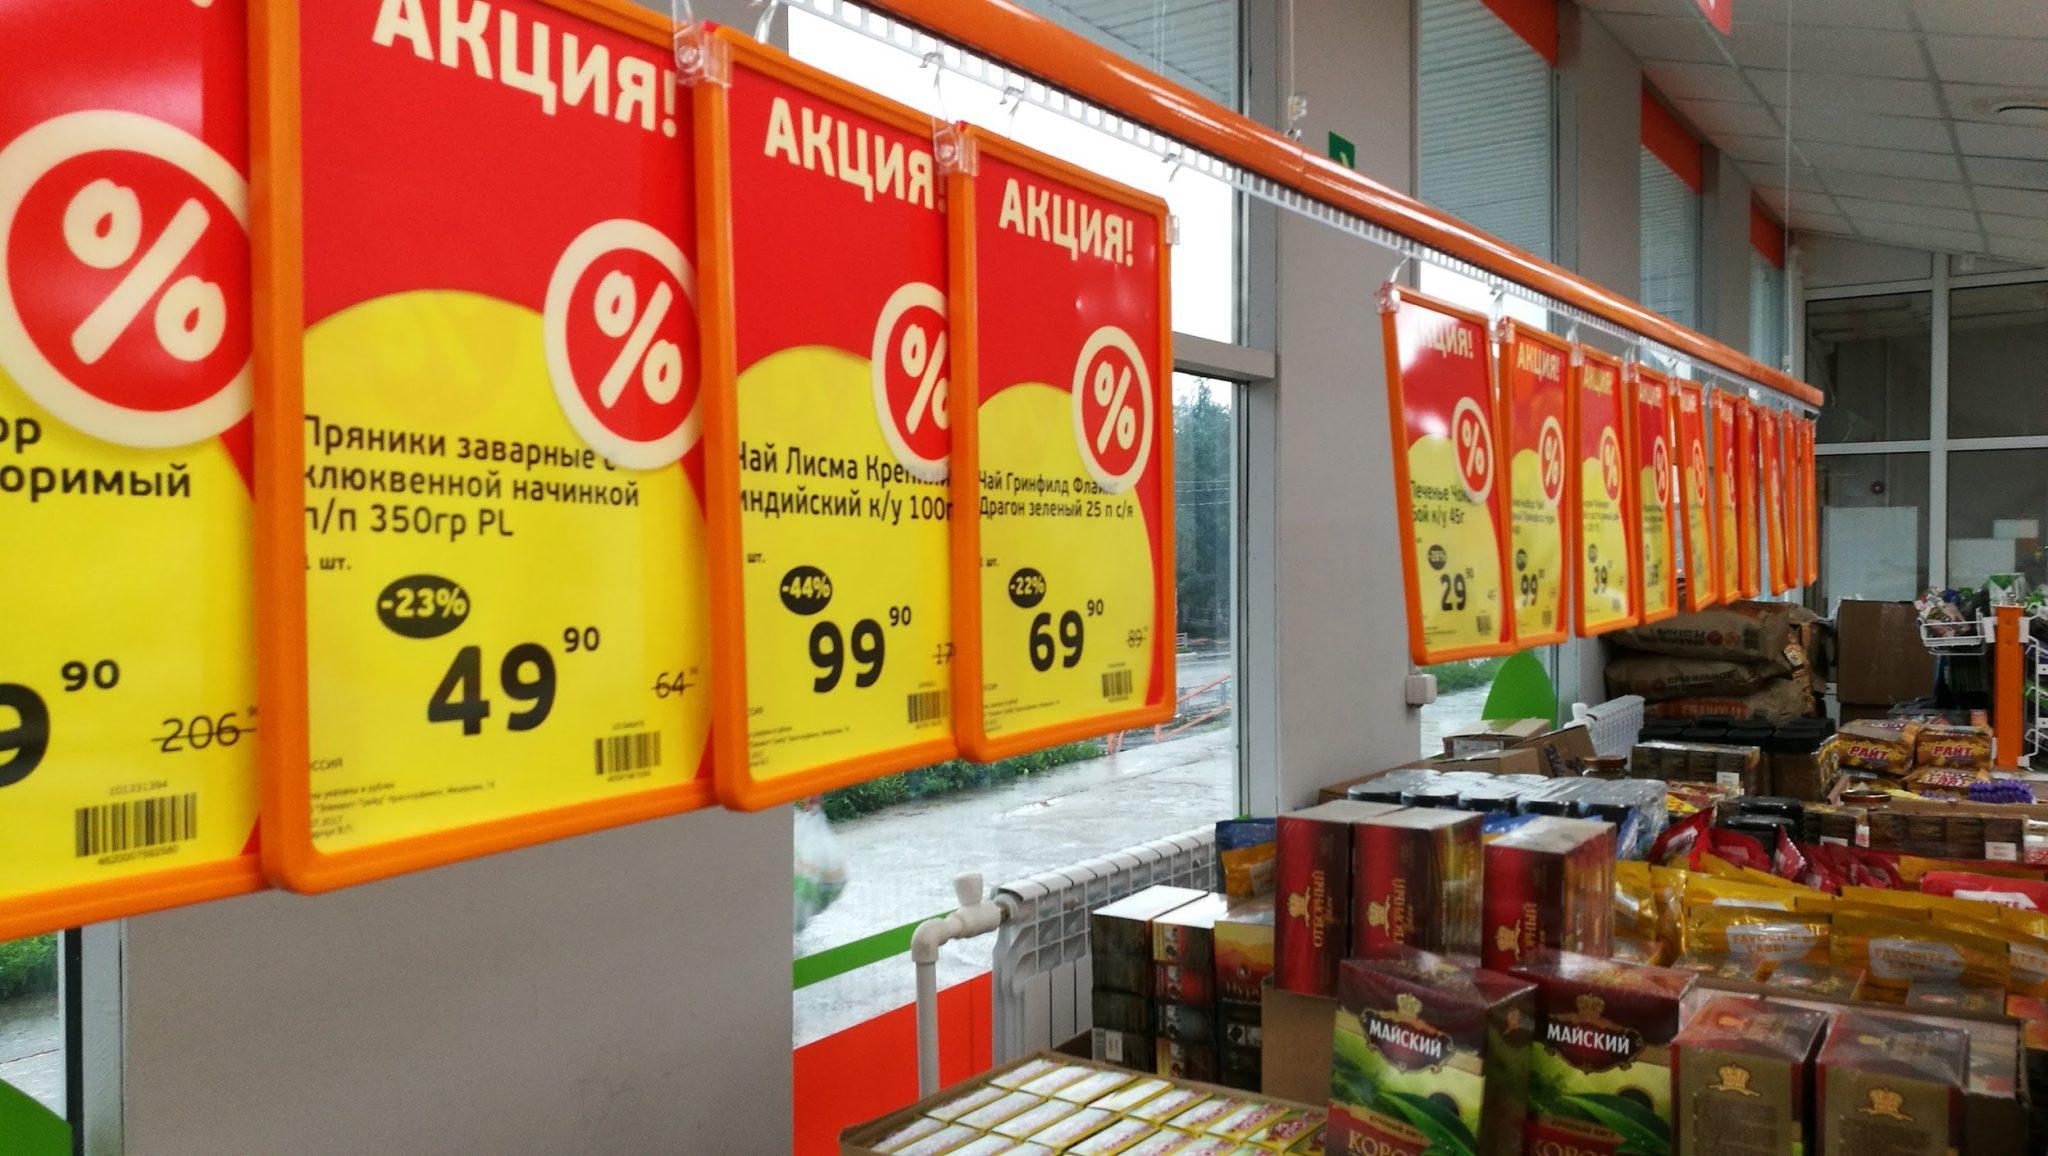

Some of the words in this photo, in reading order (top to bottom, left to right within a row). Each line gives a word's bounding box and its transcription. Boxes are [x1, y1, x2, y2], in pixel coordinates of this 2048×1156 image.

[372, 0, 677, 137] АКЦИЯ!
[999, 178, 1134, 267] АКЦИЯ!
[457, 436, 595, 471] заварные
[786, 446, 858, 480] Лисма
[0, 463, 191, 503] оримый
[513, 473, 638, 507] начинкой
[979, 470, 1002, 490] Чай
[1007, 472, 1069, 497] Гринфилд
[370, 504, 466, 542] 350гр
[479, 510, 513, 536] PL
[869, 491, 902, 526] к/у
[910, 495, 953, 521] 100г
[979, 496, 1025, 520] Драгон
[1029, 499, 1082, 518] зеленый
[1086, 500, 1102, 518] 25
[320, 558, 351, 570] шт.
[782, 576, 831, 600] -44%
[1010, 575, 1045, 596] -22%
[1440, 573, 1466, 611] 29
[1521, 573, 1538, 606] 99
[382, 588, 467, 618] -23%
[809, 618, 885, 694] 99
[889, 605, 911, 627] 90
[1029, 610, 1084, 673] 69
[1087, 599, 1104, 616] 90
[61, 659, 120, 692] 90
[428, 643, 556, 736] 49
[564, 627, 599, 652] 90
[655, 671, 684, 699] 64
[160, 713, 240, 752] 206
[1369, 1019, 1441, 1058] МАЙСКИЙ
[1548, 1023, 1630, 1055] МАЙСКИЙ
